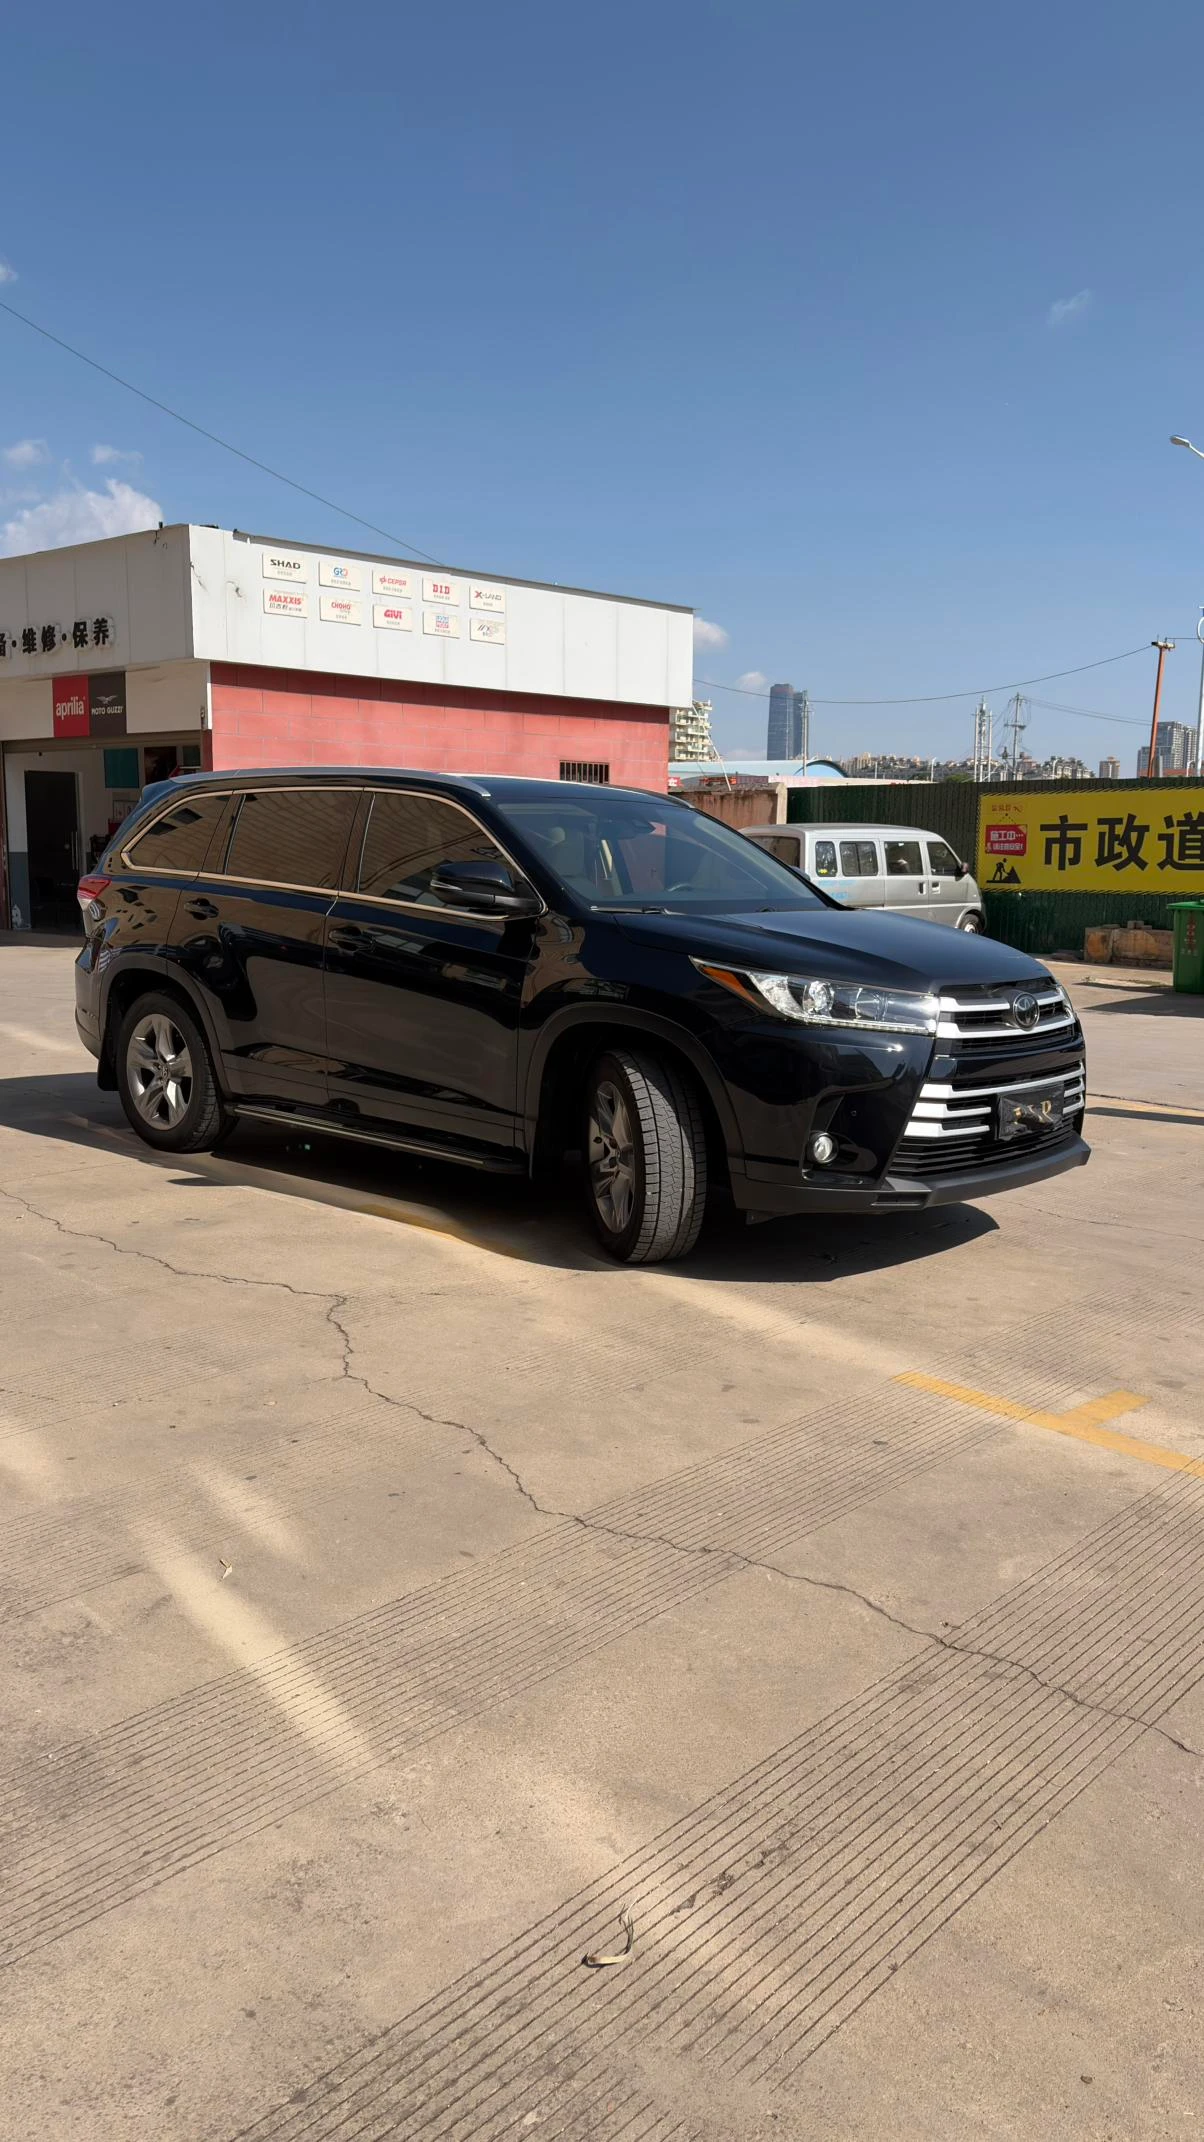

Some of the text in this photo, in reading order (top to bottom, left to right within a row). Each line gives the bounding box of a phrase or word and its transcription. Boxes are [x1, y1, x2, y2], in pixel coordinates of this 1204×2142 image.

[270, 558, 301, 571] SHAD
[269, 594, 302, 605] MAXXIS
[56, 696, 85, 720] aprilia
[91, 705, 123, 715] MOTO GUZZI
[1039, 810, 1204, 872] 市政道
